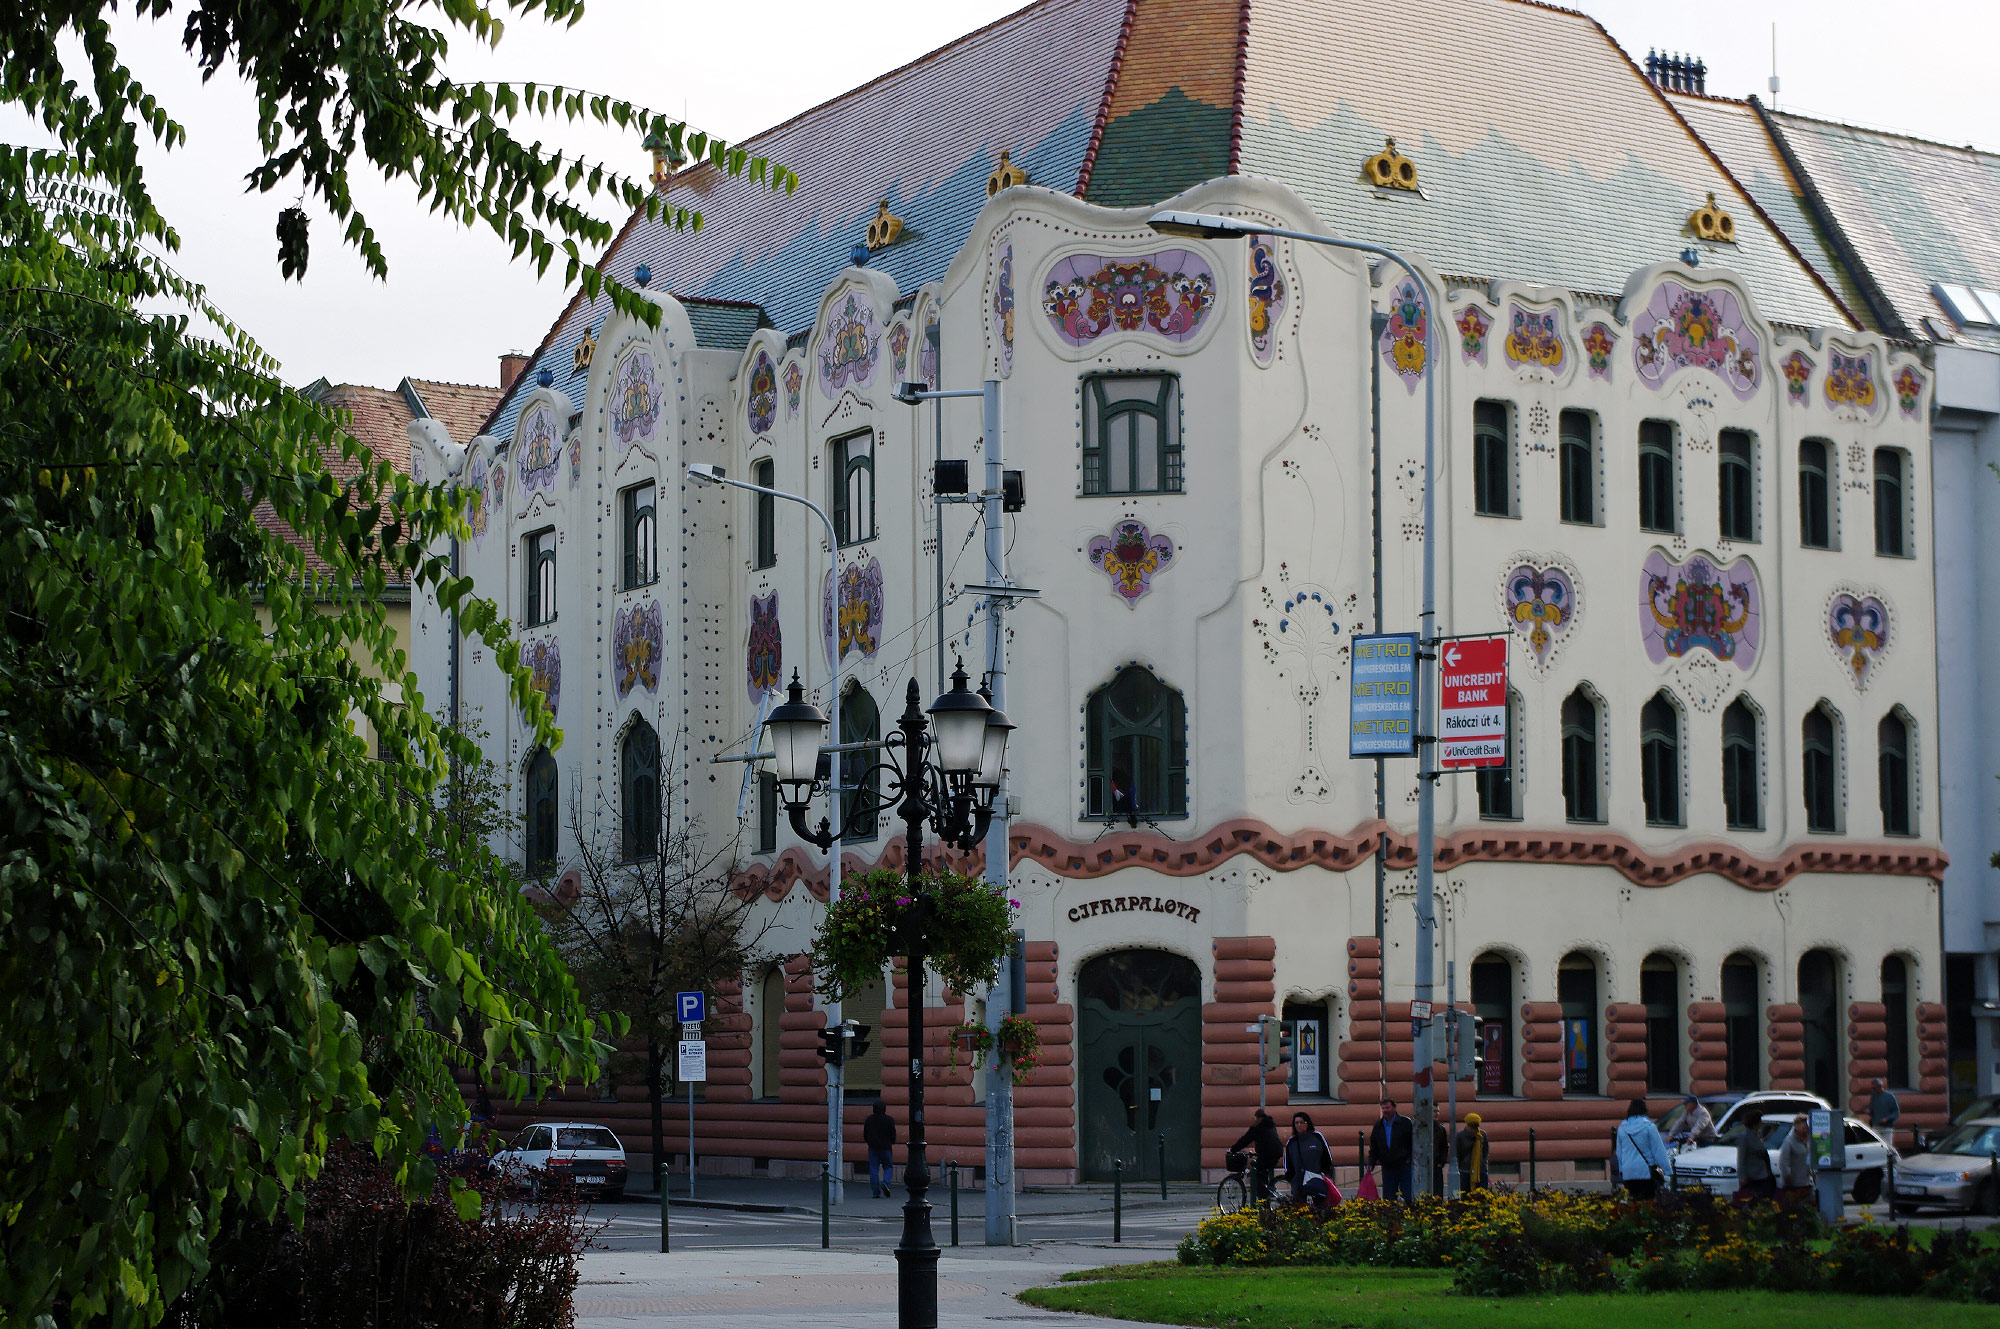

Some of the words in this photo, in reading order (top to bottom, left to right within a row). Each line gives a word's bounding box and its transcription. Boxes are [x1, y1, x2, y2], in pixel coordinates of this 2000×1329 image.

[1355, 643, 1411, 659] METRO
[1445, 673, 1503, 688] UNICREDIT
[1354, 682, 1410, 697] METRO
[1458, 689, 1488, 703] BANK
[1353, 719, 1409, 735] METRO
[1446, 714, 1478, 729] Rákóczi
[1481, 714, 1491, 727] út
[1493, 714, 1501, 726] 4.
[1452, 745, 1483, 757] UniCredit
[1484, 744, 1501, 755] Bank
[1068, 896, 1201, 924] CIFRAPALOTA
[682, 996, 699, 1018] P
